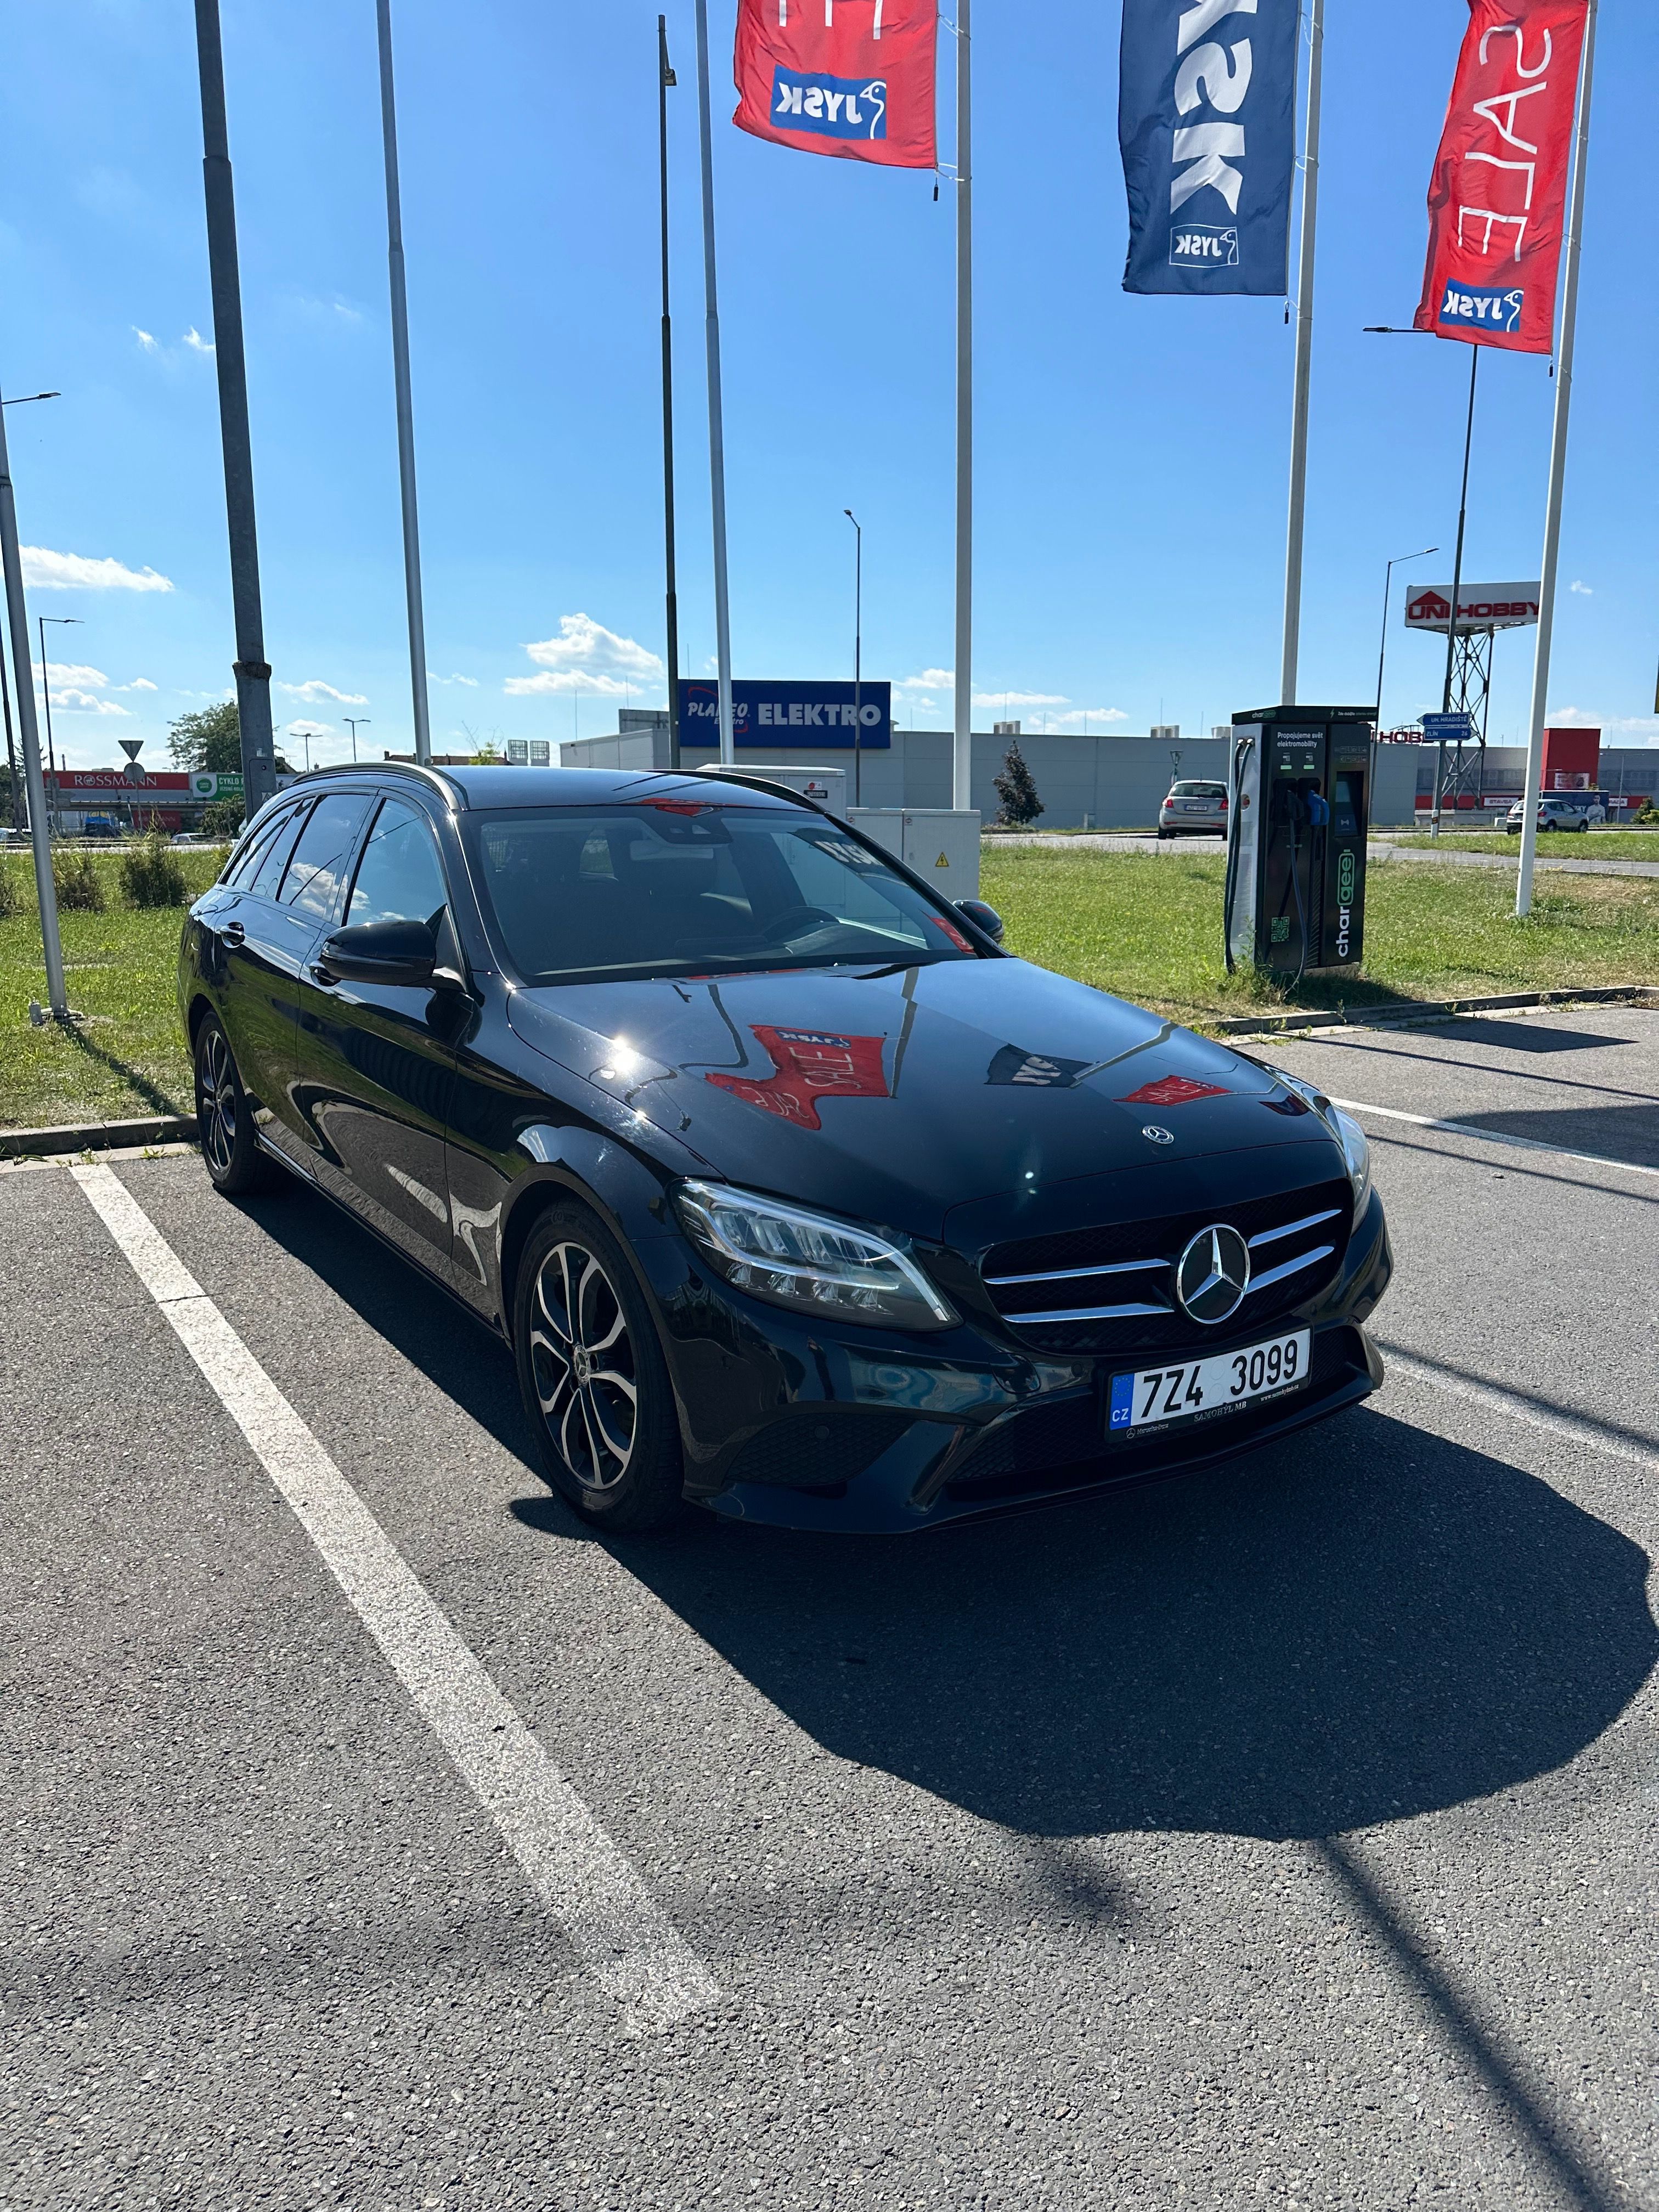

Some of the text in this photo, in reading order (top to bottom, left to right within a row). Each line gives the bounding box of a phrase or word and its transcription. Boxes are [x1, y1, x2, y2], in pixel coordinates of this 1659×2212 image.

[758, 703, 882, 726] ELEKTRO
[1380, 731, 1434, 743] HOB
[1336, 856, 1353, 957] chargee
[1141, 1339, 1297, 1418] 7Z4 3099
[1112, 1408, 1129, 1422] CZ
[1234, 1401, 1247, 1411] MB
